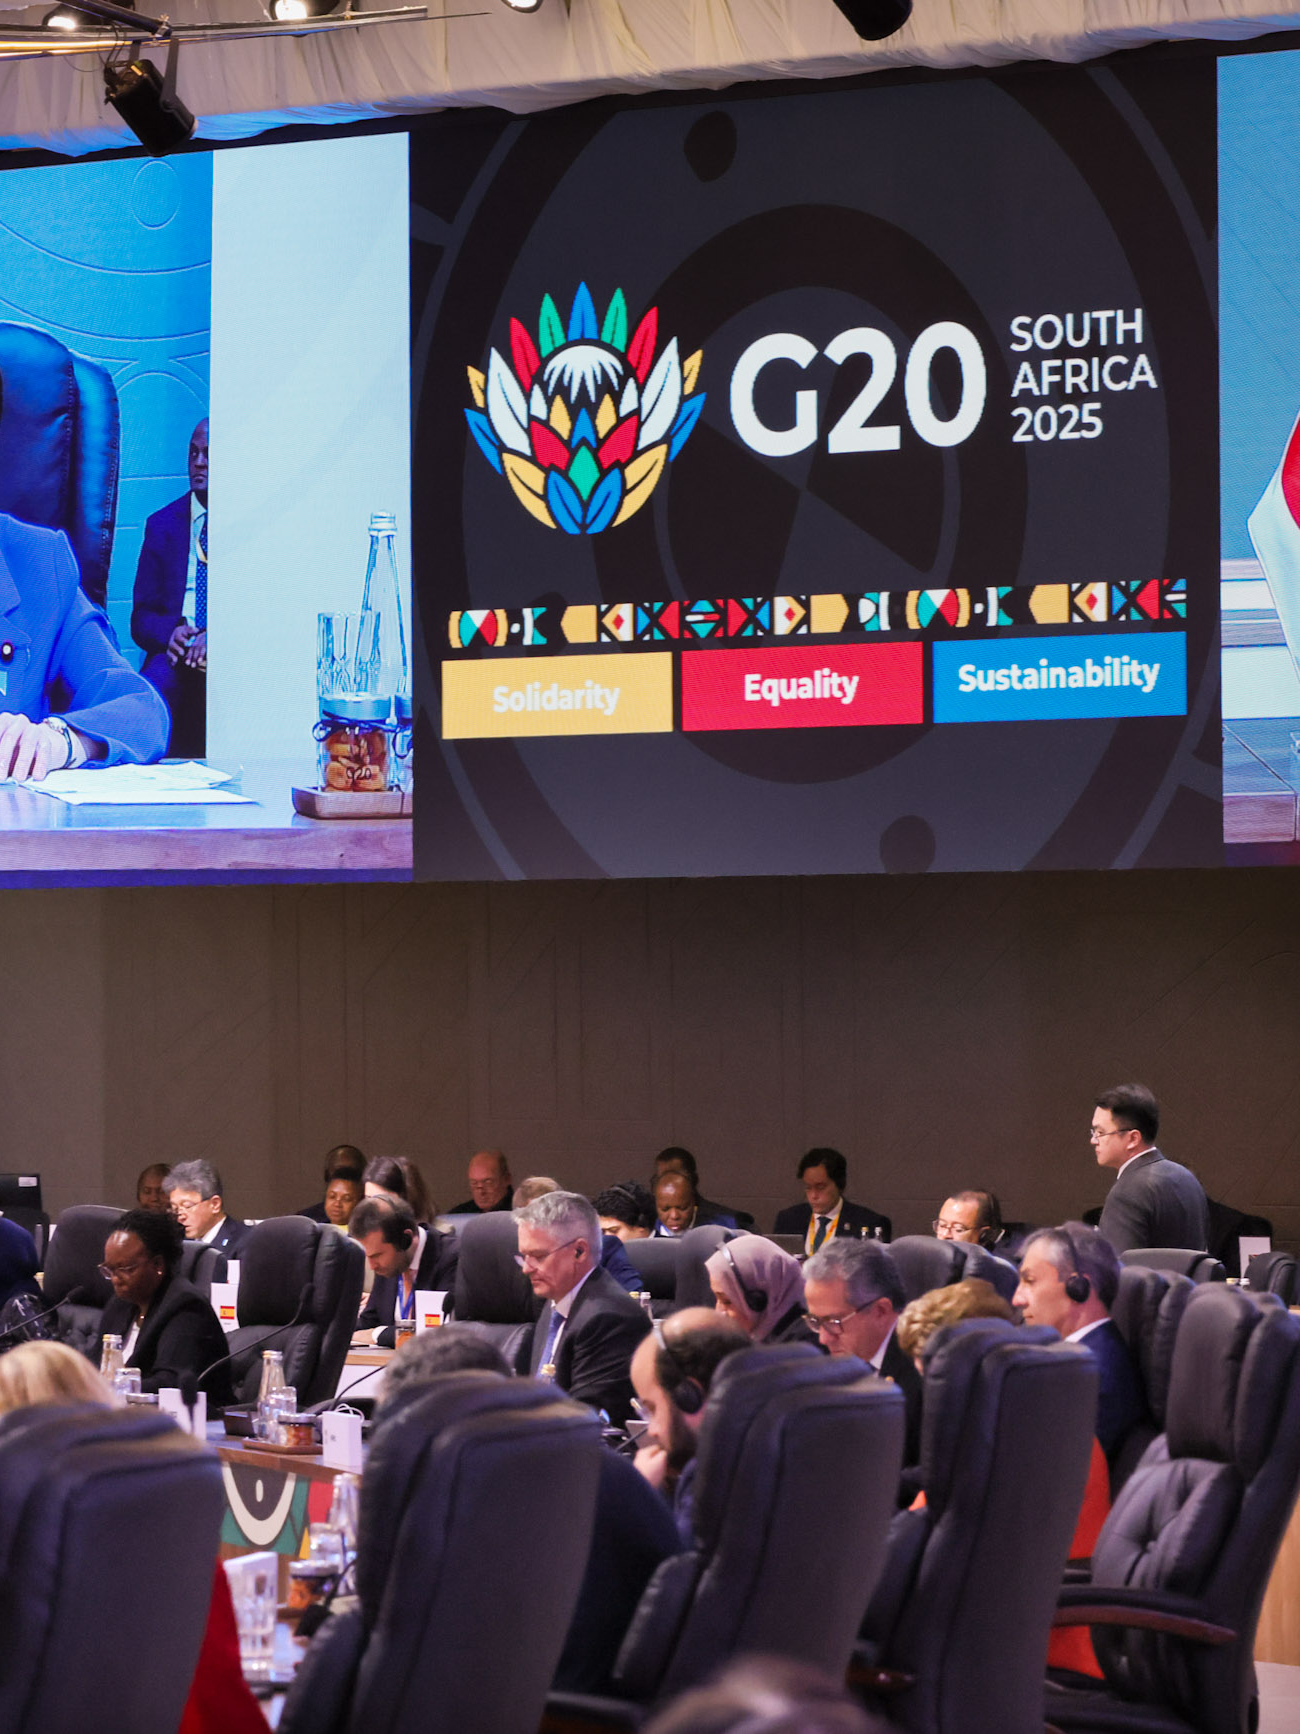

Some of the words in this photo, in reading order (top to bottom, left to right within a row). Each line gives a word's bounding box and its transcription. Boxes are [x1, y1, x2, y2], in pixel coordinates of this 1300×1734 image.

[1010, 308, 1143, 352] SOUTH
[730, 321, 987, 457] G20
[1011, 353, 1159, 398] AFRICA
[1011, 402, 1104, 442] 2025
[743, 669, 860, 704] Equality
[957, 656, 1162, 697] Sustainability
[492, 679, 621, 716] Solidarity
